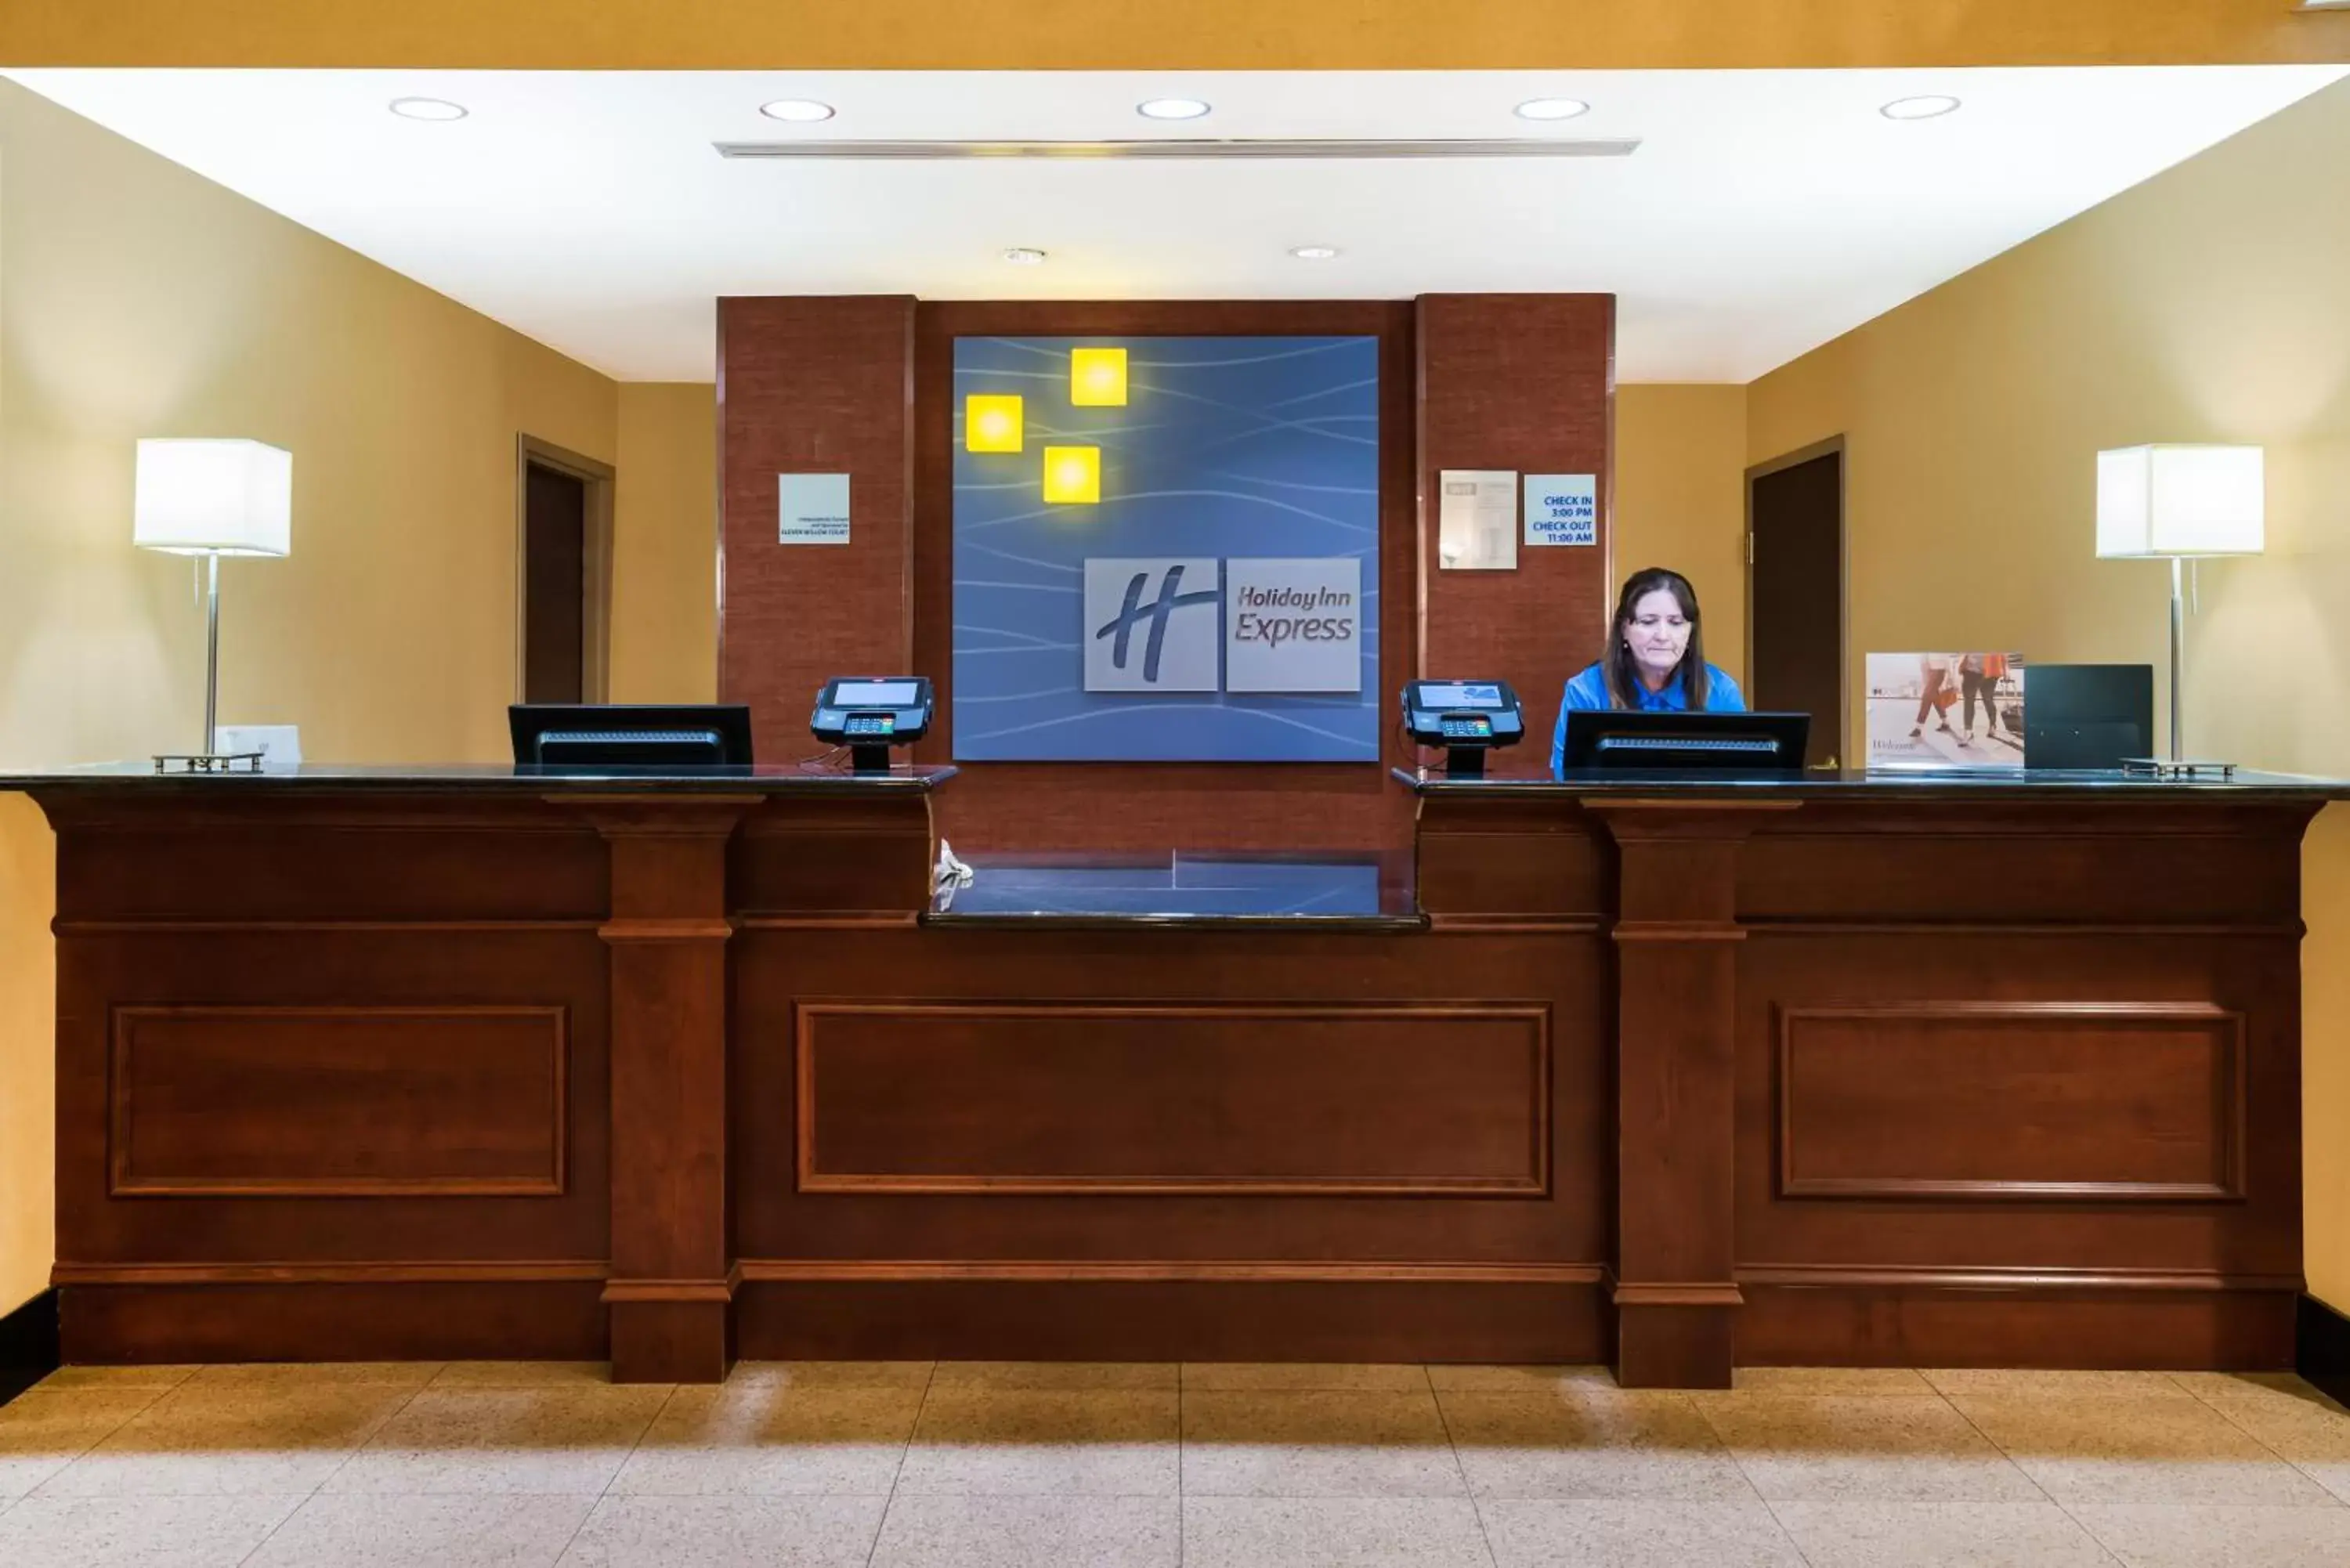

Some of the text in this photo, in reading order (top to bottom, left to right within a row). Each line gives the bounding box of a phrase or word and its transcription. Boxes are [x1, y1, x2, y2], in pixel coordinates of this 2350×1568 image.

[1544, 496, 1593, 506] CHECK IN
[1552, 508, 1593, 518] 3:00 PM
[1533, 521, 1593, 531] CHECK OUT
[1547, 533, 1593, 544] 11:00 AM
[1237, 586, 1351, 611] Holiday Inn
[1235, 612, 1353, 649] Express
